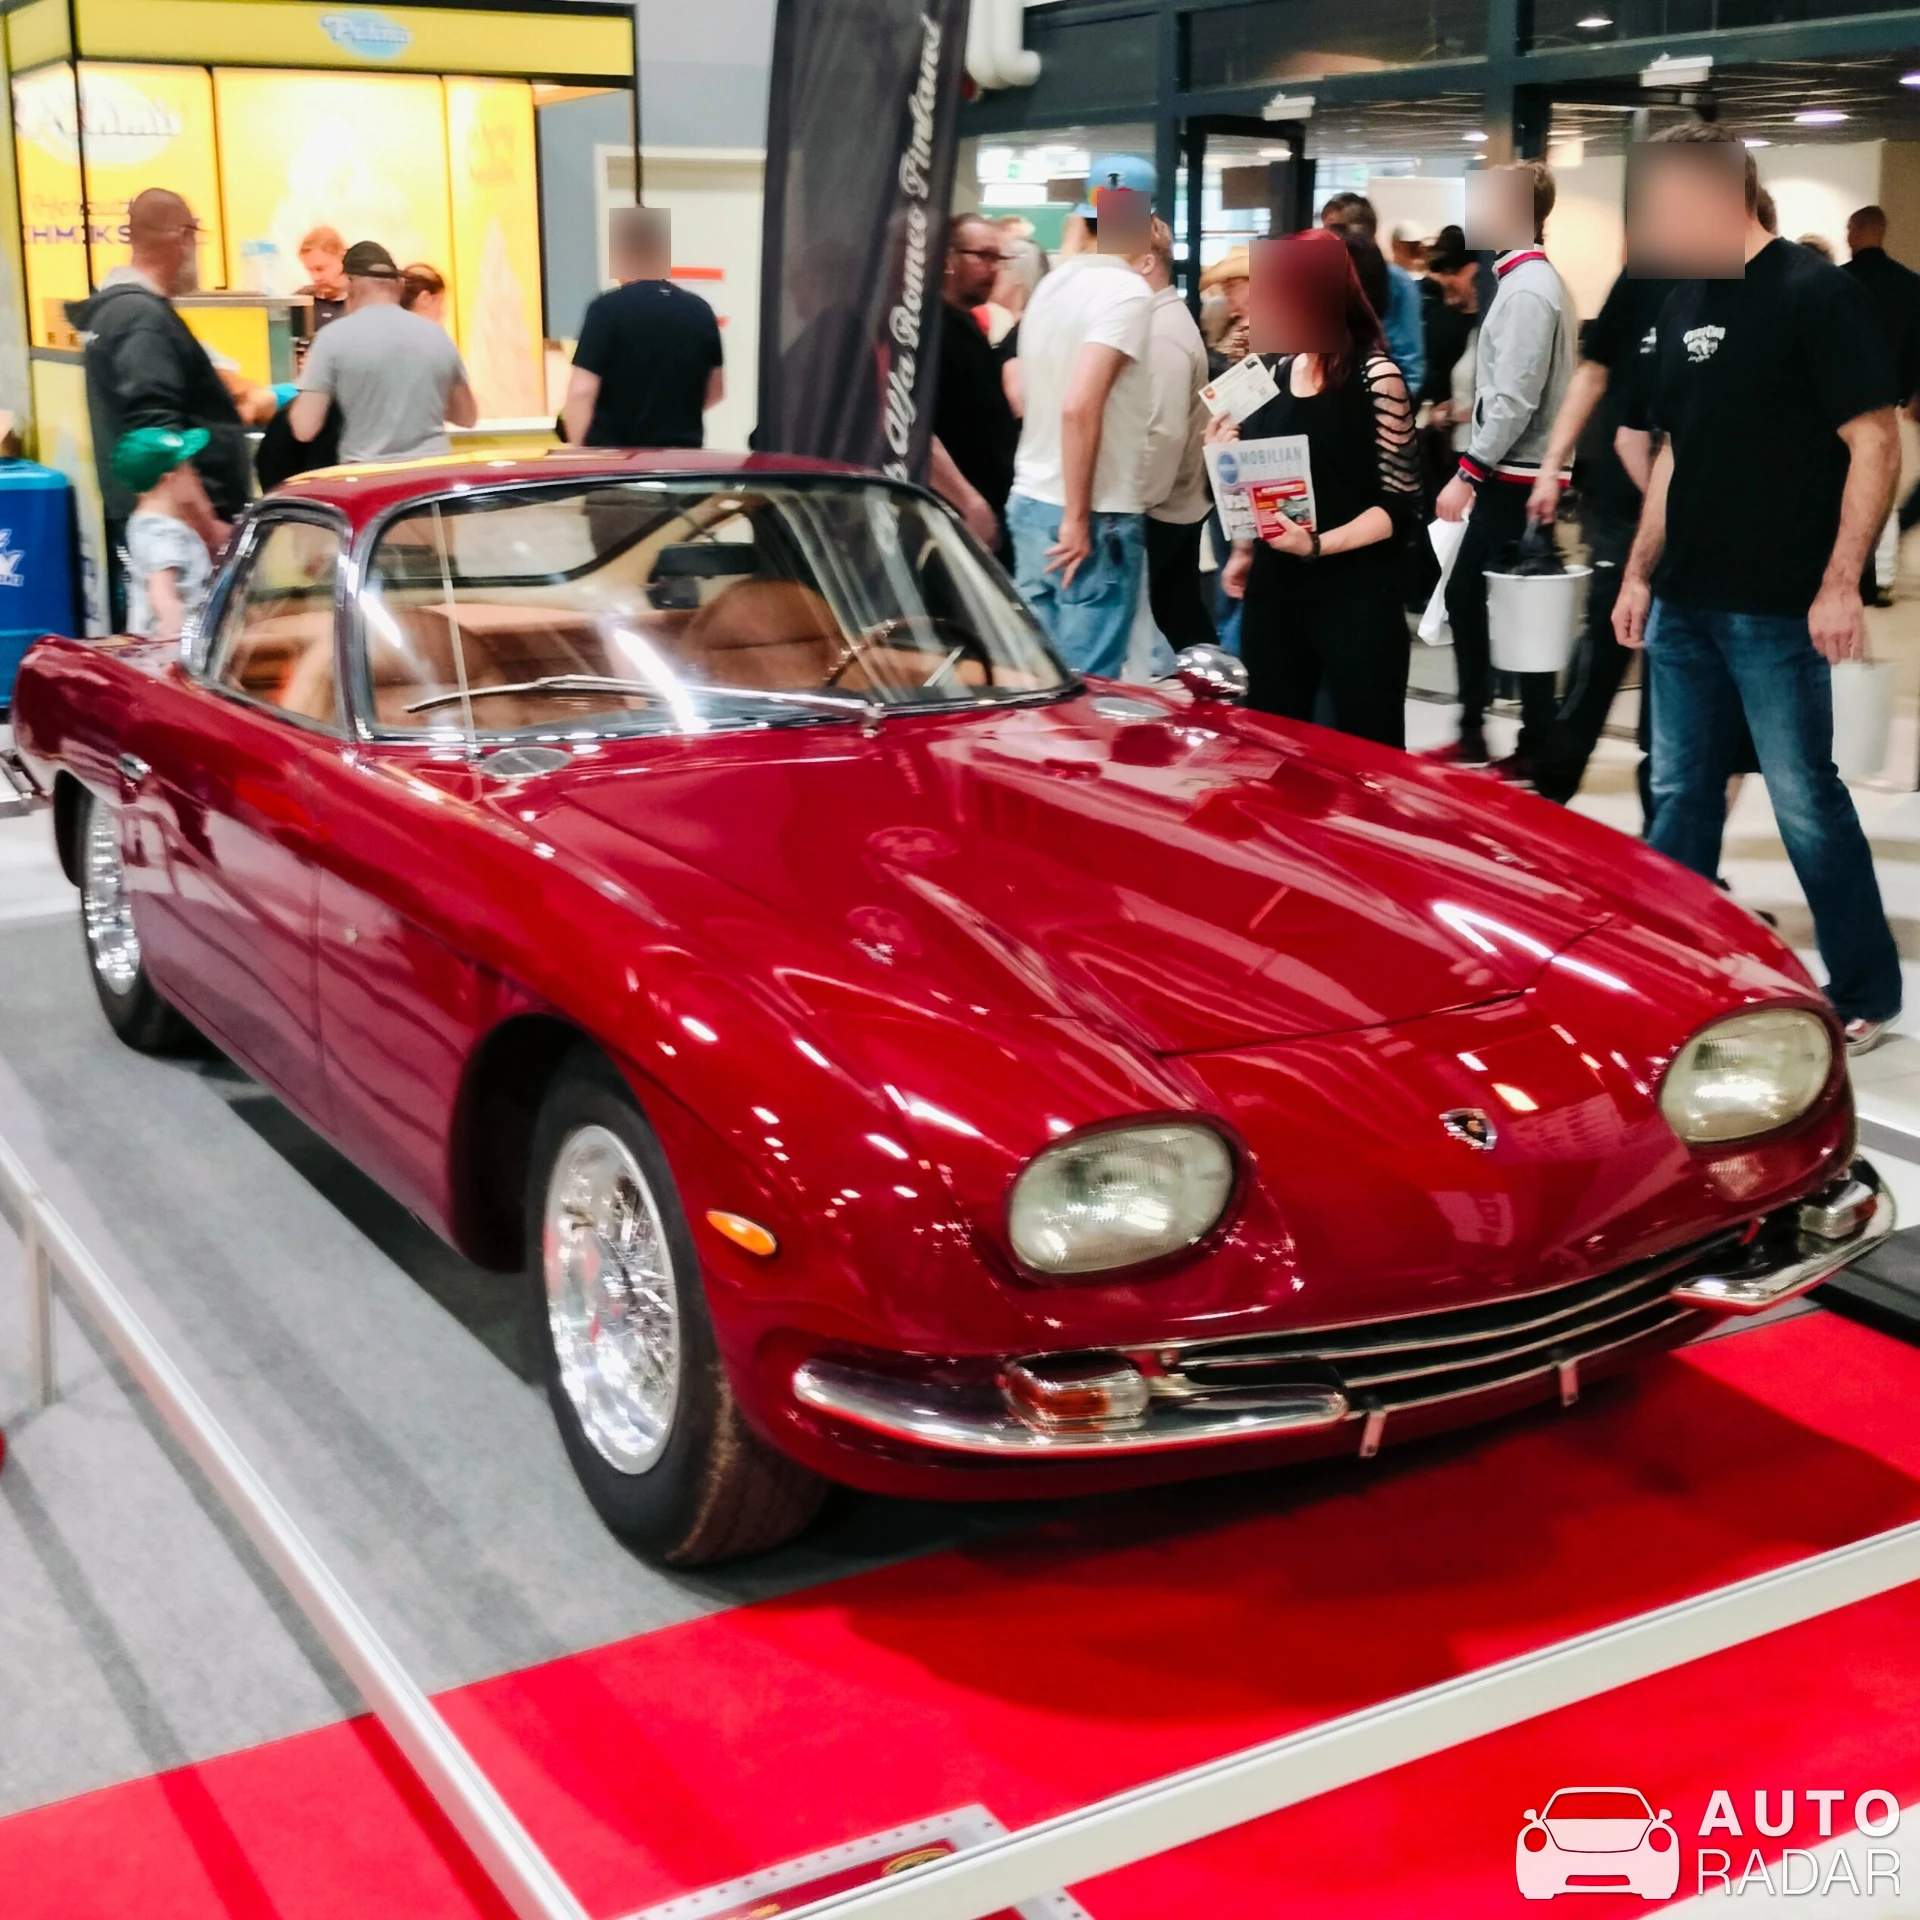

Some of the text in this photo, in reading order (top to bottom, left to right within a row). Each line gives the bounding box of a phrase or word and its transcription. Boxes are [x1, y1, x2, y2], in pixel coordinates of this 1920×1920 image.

[899, 12, 942, 200] Finland
[889, 200, 928, 350] Romeo
[885, 351, 919, 457] Alfa
[1239, 445, 1303, 466] MOBILIAN
